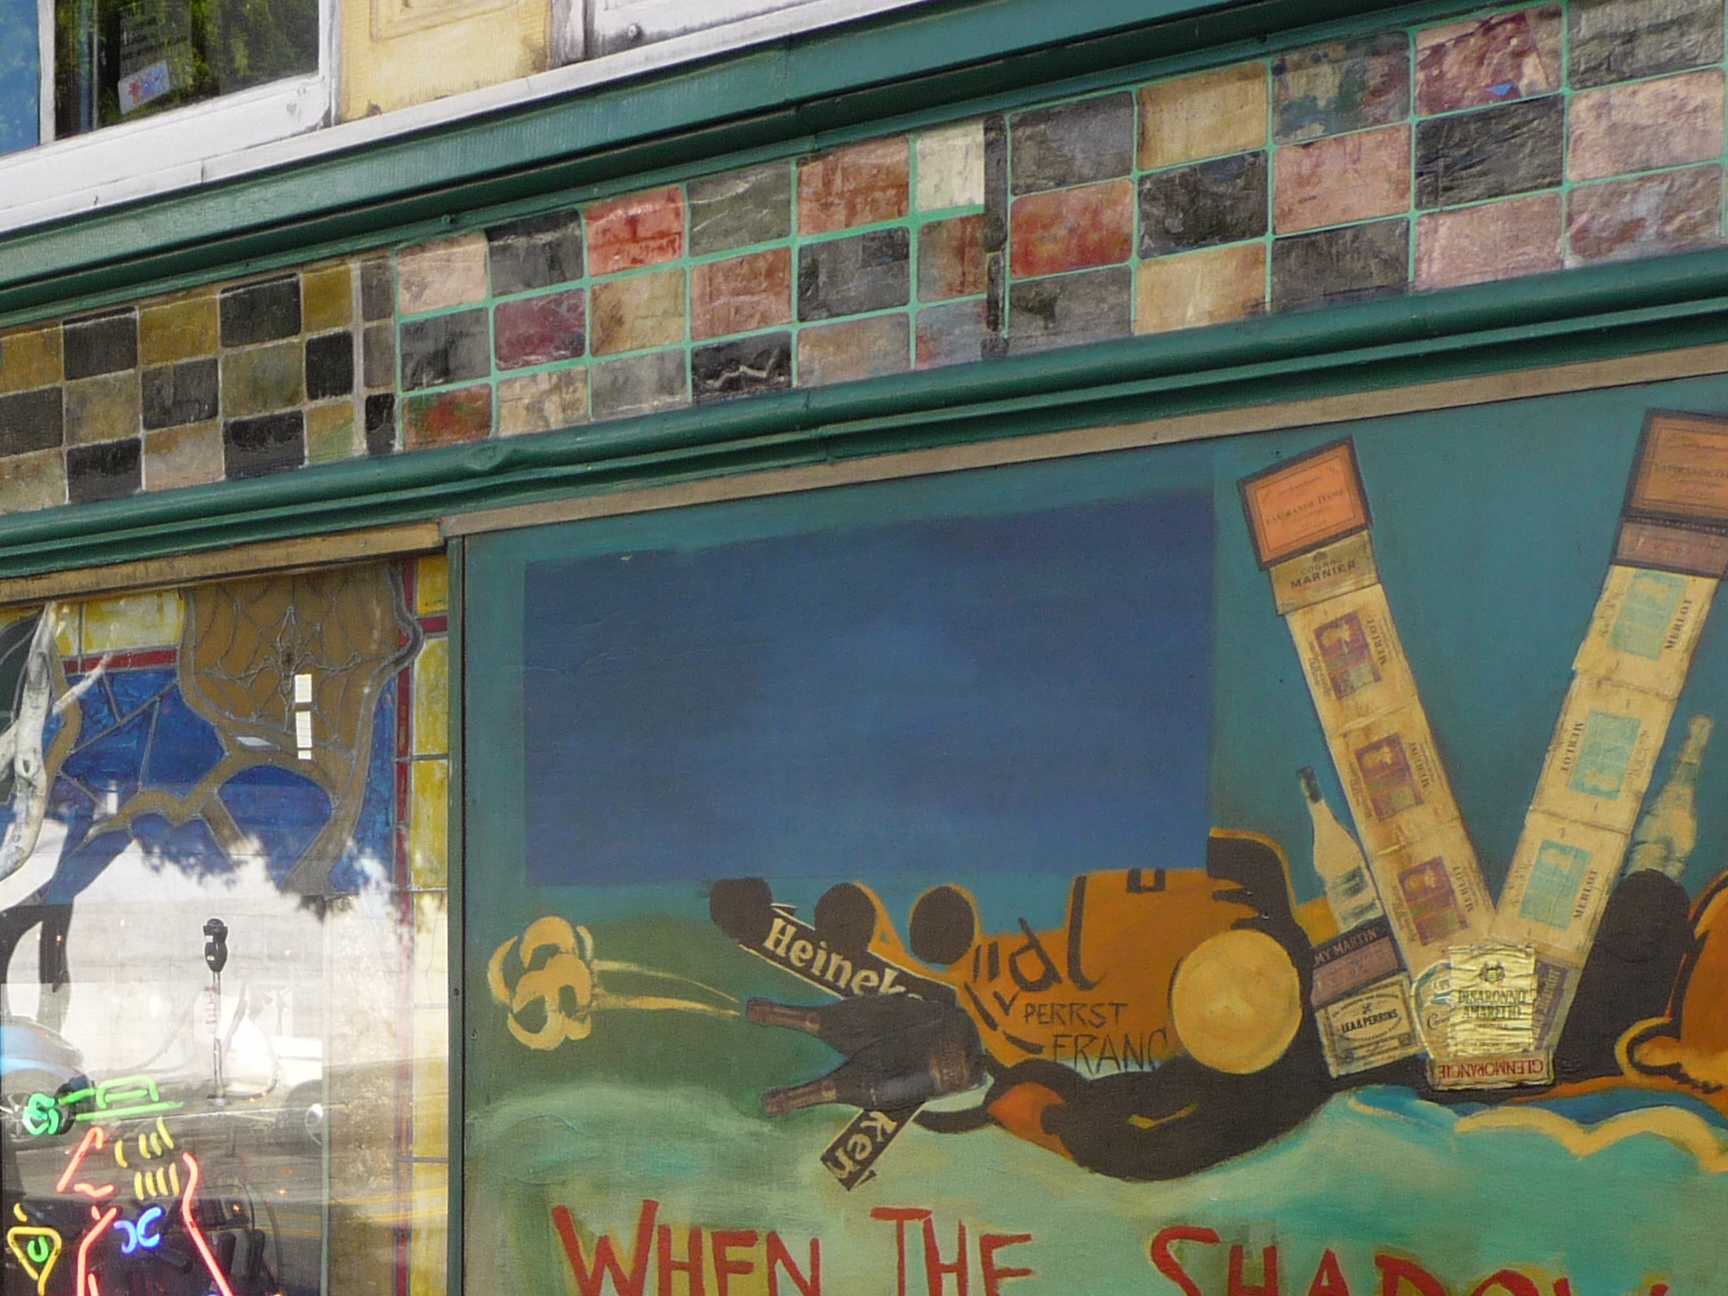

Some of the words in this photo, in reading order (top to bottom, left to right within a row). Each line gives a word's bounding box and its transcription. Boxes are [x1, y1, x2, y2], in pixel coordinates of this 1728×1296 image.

[1290, 560, 1357, 589] MARNIER
[1300, 556, 1343, 576] COGNAC
[1663, 595, 1696, 653] MERLOT
[1366, 614, 1389, 666] MERLOT
[1560, 721, 1584, 772] MERLOT
[1452, 864, 1475, 913] MERLOT
[1573, 869, 1599, 921] MERLOT
[1334, 928, 1378, 954] MARTIN
[1458, 989, 1525, 1004] DISARONNO
[1462, 1005, 1521, 1021] AMARETTO
[1438, 1059, 1544, 1079] GLENMORANGIE
